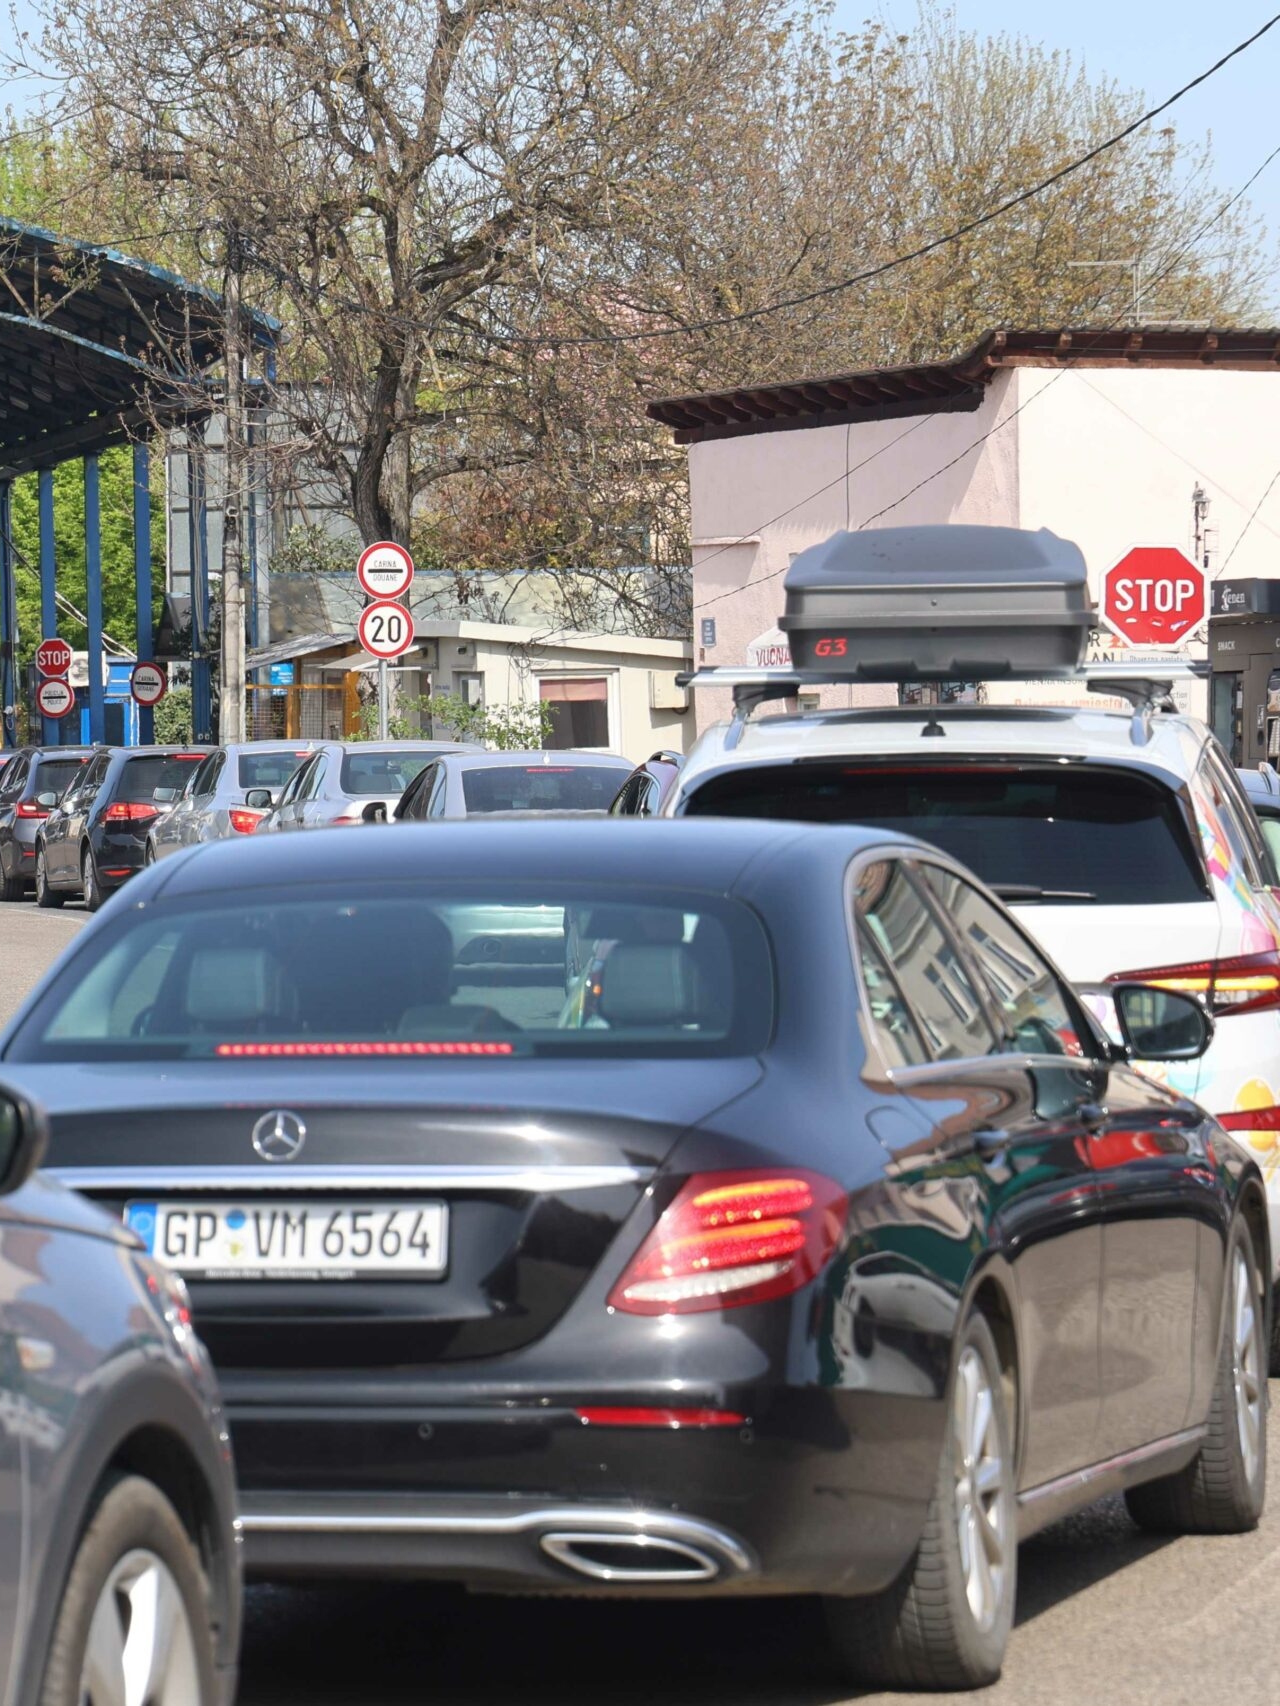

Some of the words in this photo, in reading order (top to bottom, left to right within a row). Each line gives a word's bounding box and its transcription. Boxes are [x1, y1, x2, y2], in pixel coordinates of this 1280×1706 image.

[373, 560, 397, 568] CARINA
[1115, 578, 1195, 612] STOP
[371, 615, 401, 643] 20
[39, 650, 70, 666] STOP
[815, 638, 848, 656] G3
[165, 1210, 217, 1257] GP
[254, 1210, 307, 1257] VM
[323, 1209, 429, 1257] 6564
